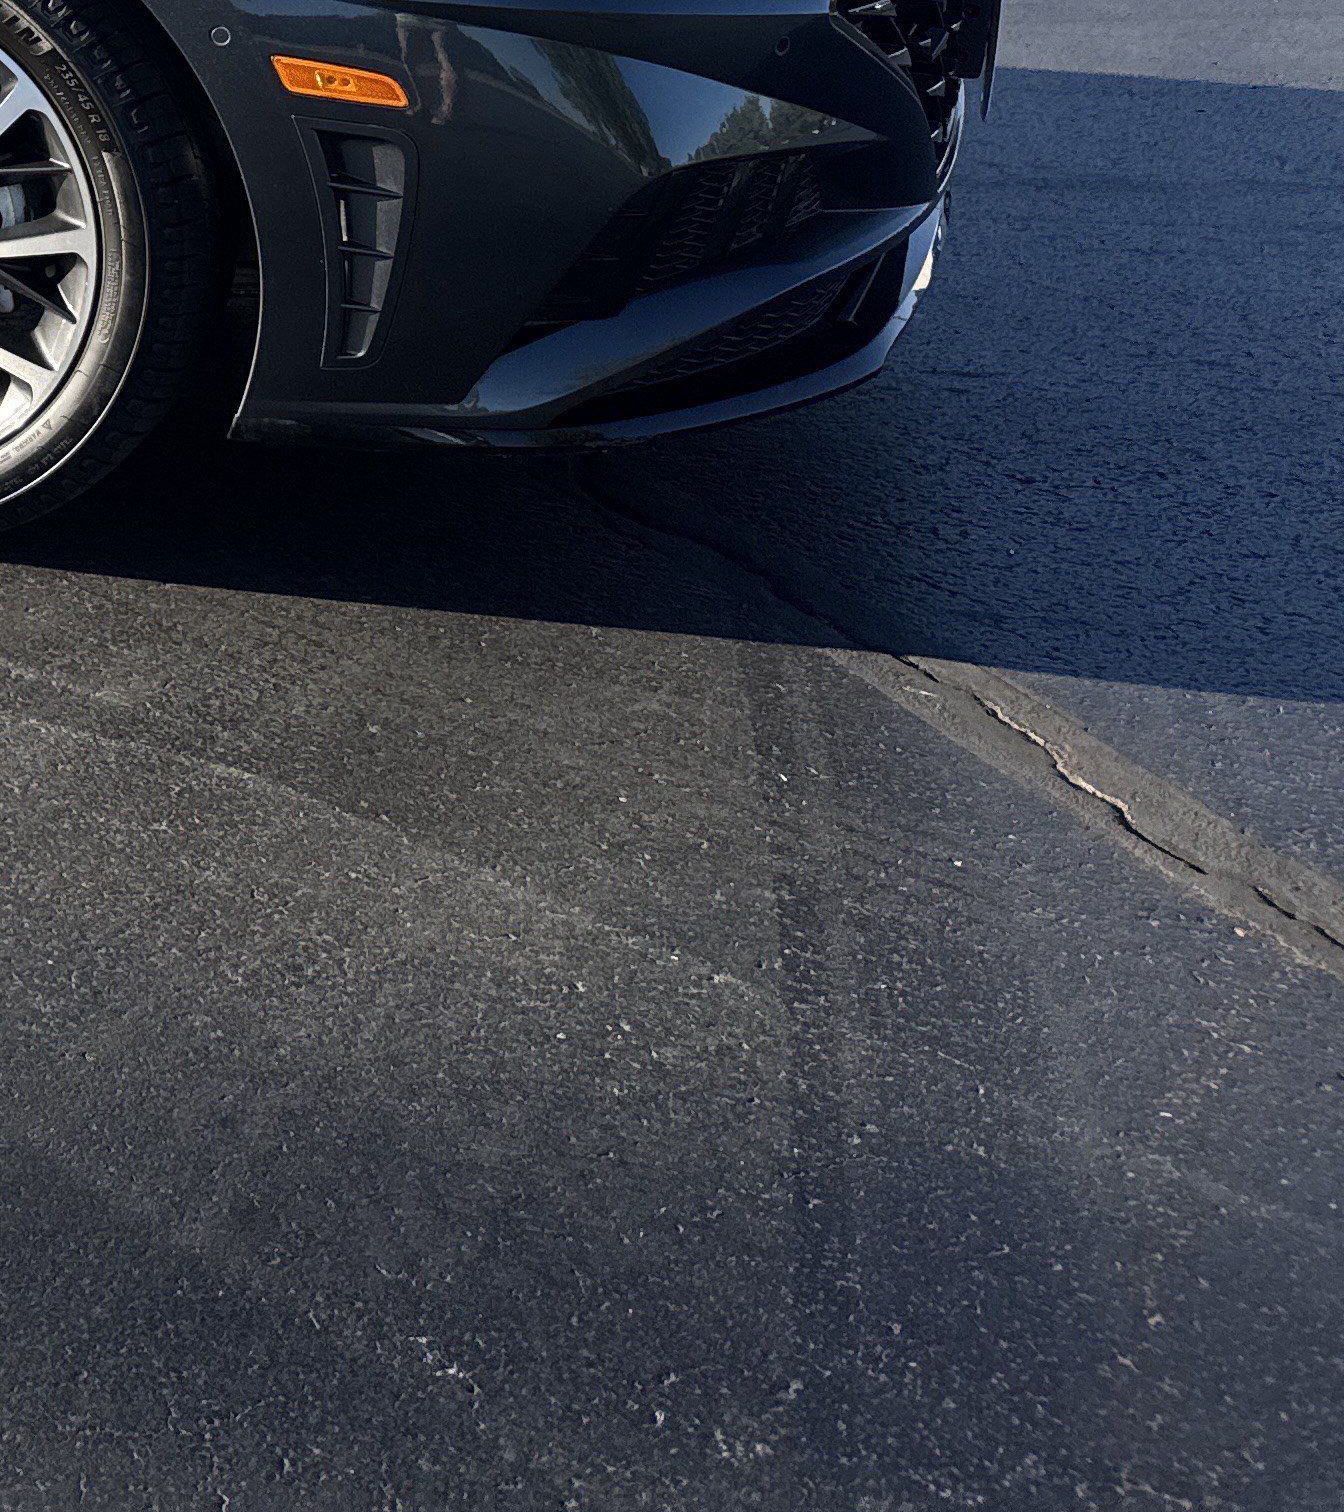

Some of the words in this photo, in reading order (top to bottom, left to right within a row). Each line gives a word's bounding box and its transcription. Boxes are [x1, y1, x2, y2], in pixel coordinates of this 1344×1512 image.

[54, 63, 94, 110] 235/45
[88, 114, 102, 123] R
[96, 129, 111, 142] 18
